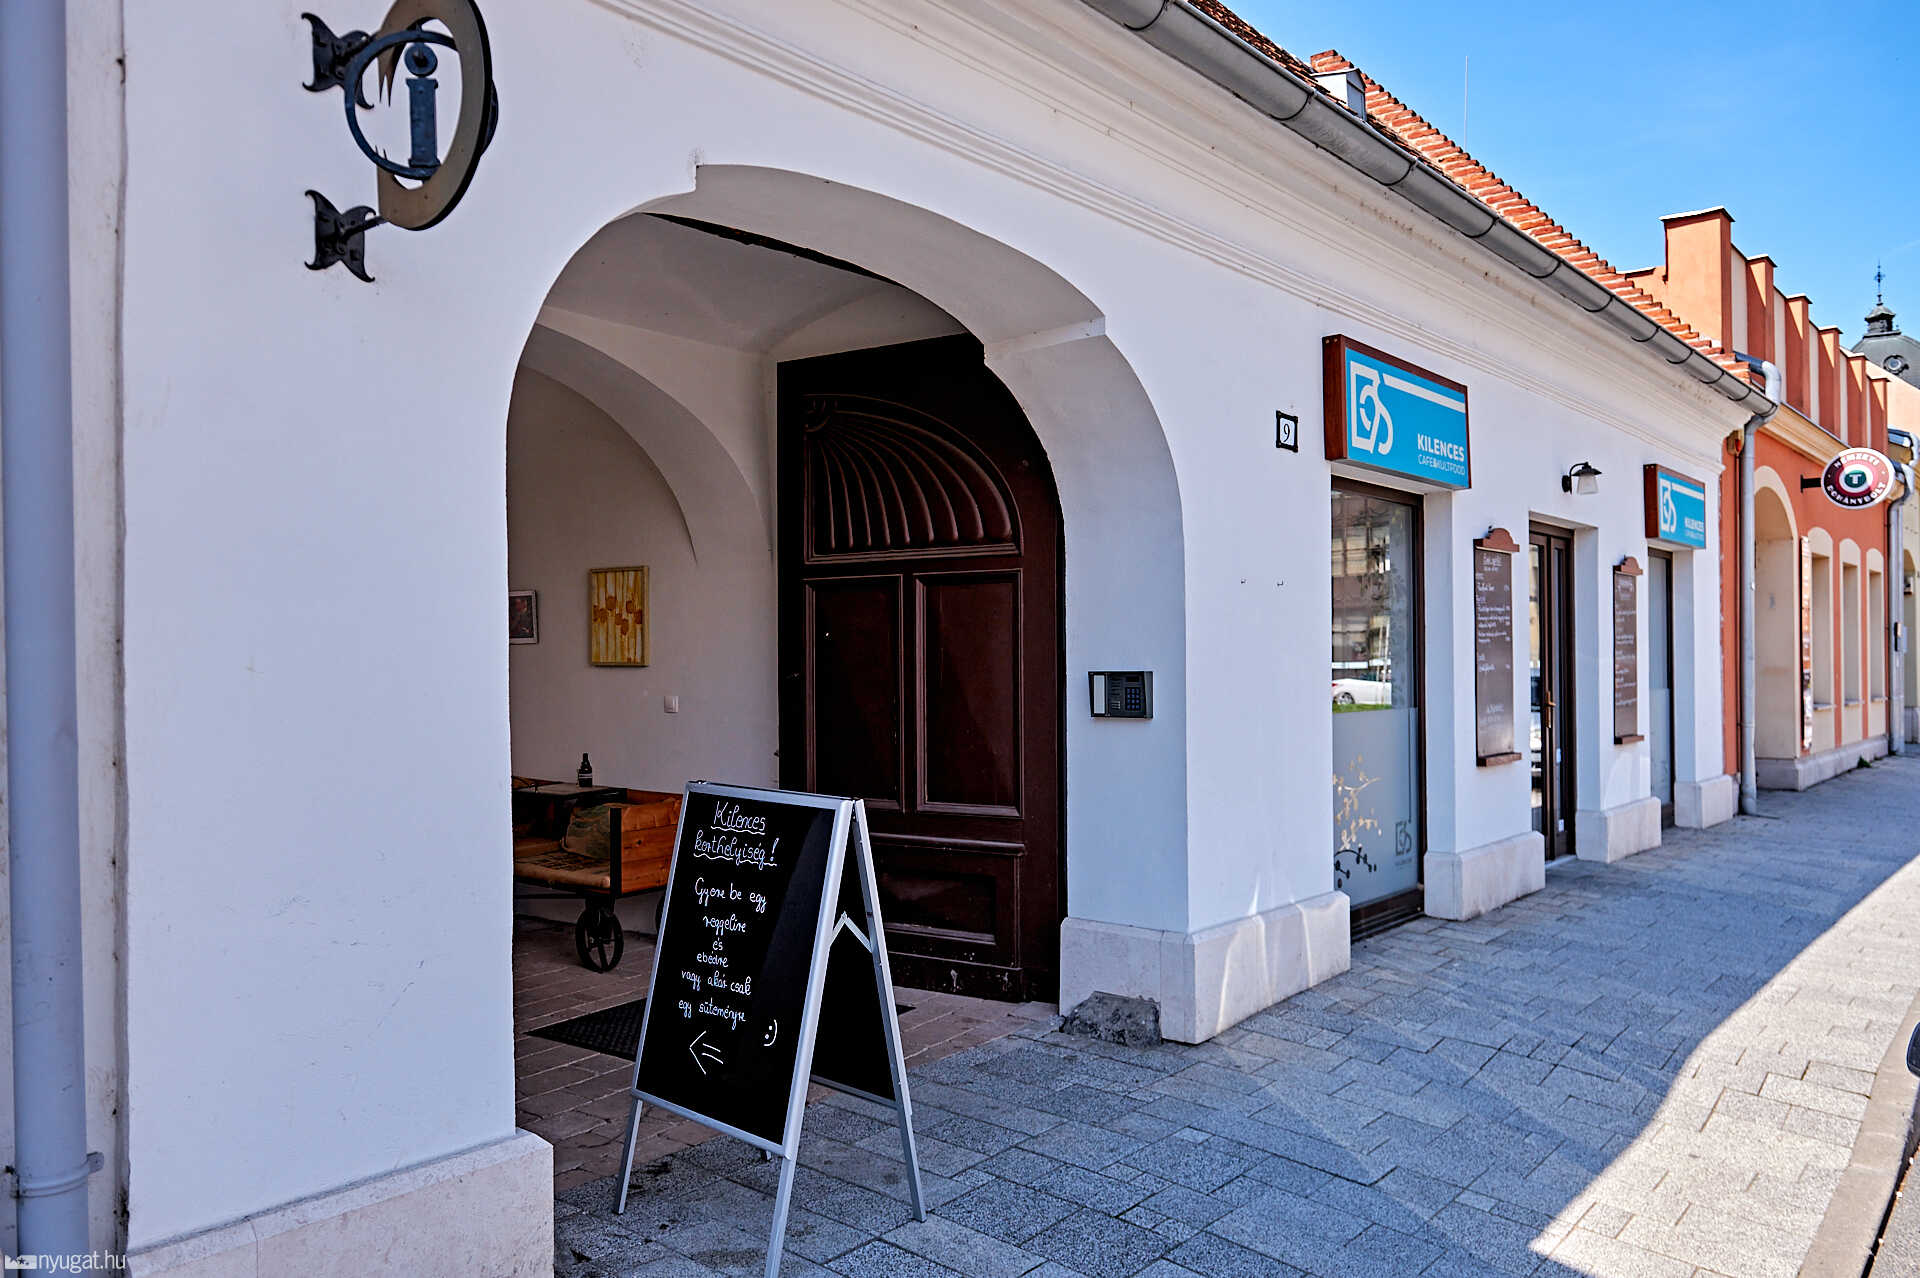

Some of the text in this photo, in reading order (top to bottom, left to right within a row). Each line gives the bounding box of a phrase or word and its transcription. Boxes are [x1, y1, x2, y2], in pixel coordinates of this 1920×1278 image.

[1283, 423, 1291, 443] 9
[1417, 432, 1465, 462] KILENCES
[730, 882, 742, 900] be
[749, 892, 767, 913] egy
[712, 937, 723, 951] és
[681, 970, 752, 996] vagy akár csak
[678, 1000, 692, 1019] egy
